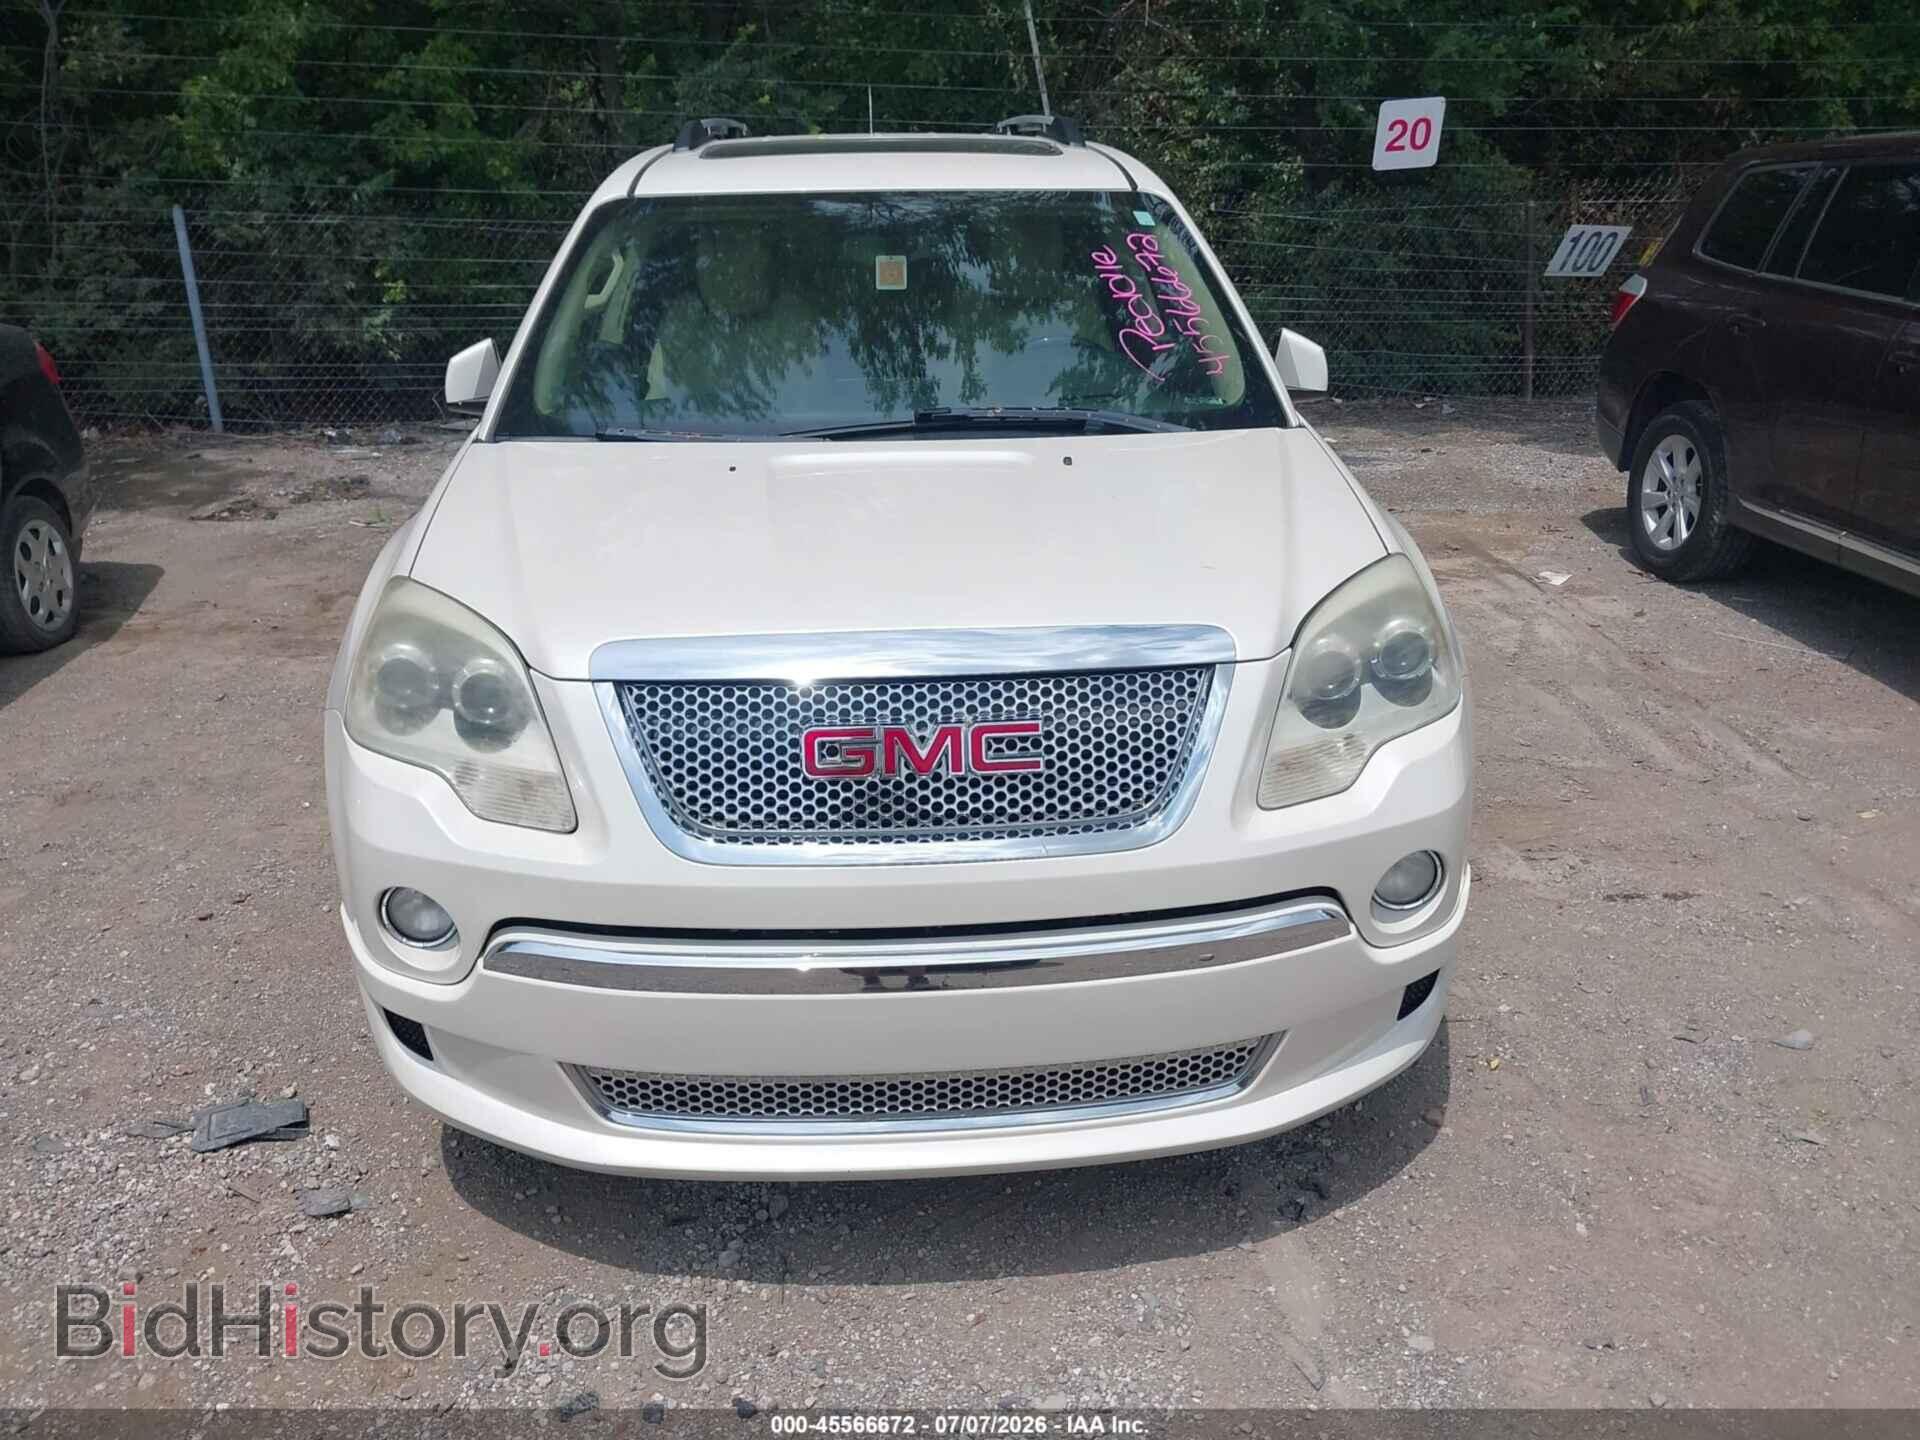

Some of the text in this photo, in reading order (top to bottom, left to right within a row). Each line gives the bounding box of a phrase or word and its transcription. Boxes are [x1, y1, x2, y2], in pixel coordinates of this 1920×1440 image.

[1385, 117, 1432, 152] 20
[1559, 230, 1618, 272] 100
[803, 719, 1043, 780] GMC
